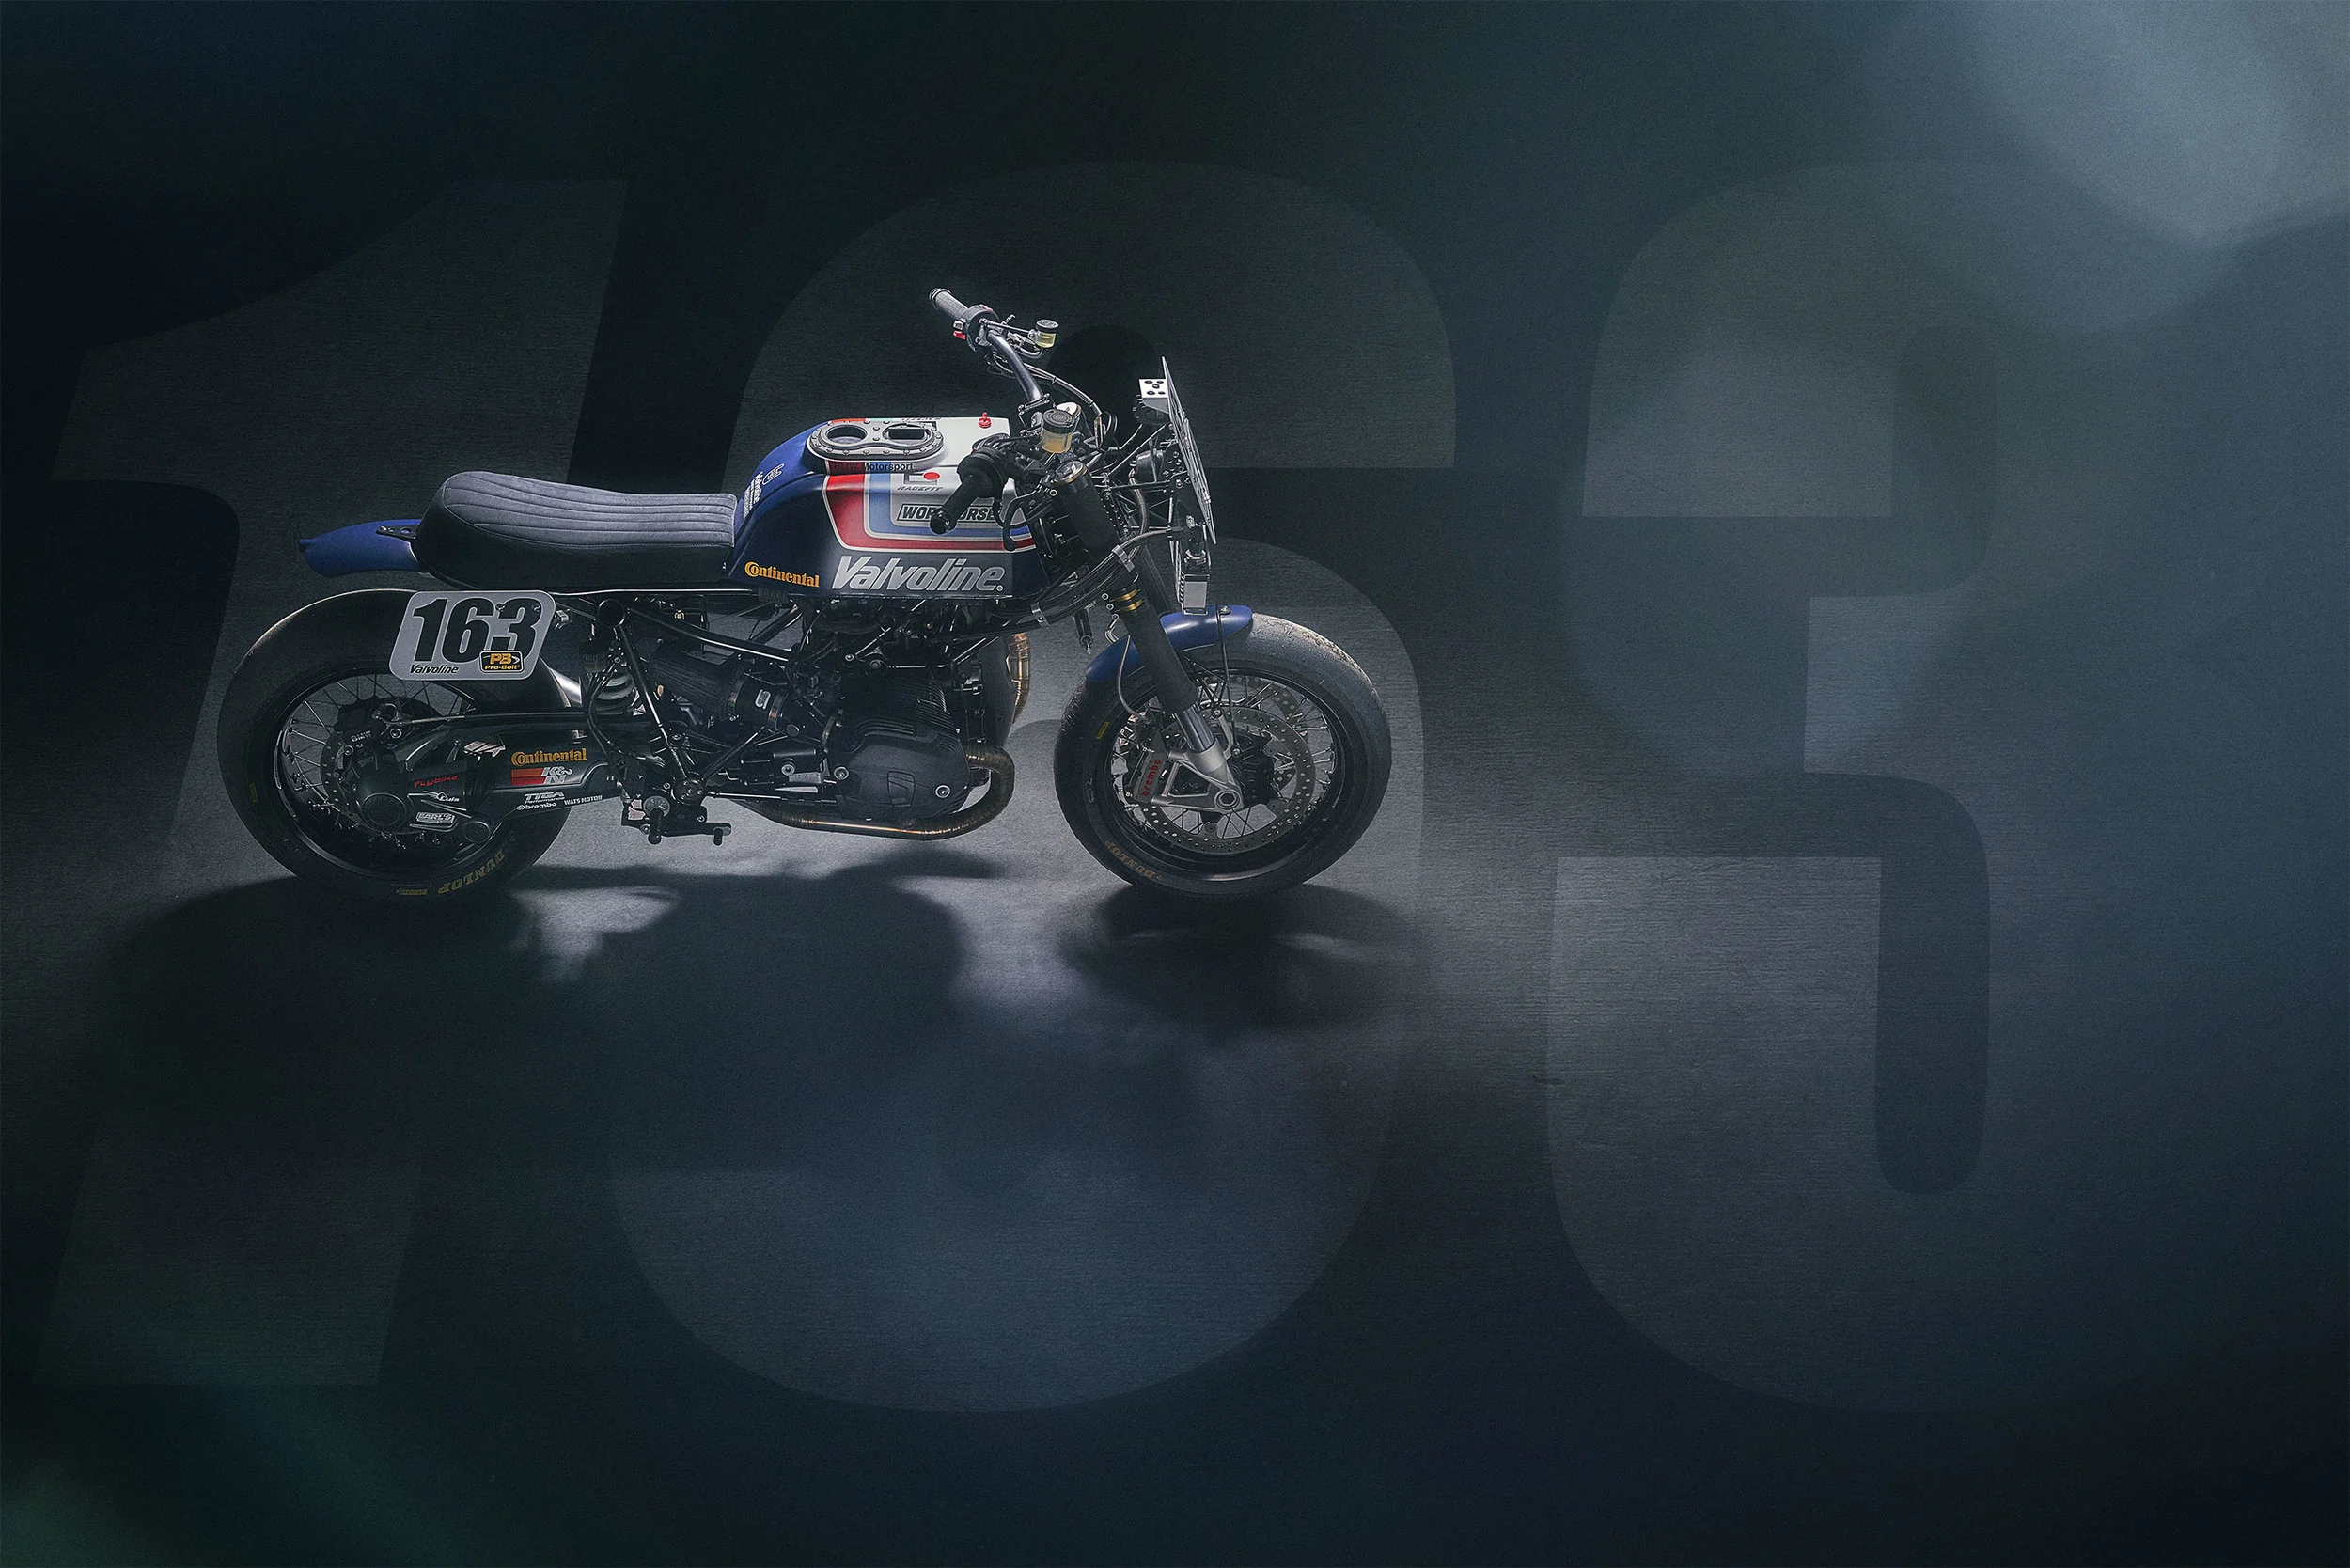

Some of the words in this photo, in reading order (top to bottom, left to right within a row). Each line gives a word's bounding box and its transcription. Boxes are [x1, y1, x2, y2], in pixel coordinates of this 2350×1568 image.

[865, 462, 914, 472] Motorsport
[744, 561, 820, 588] Continental
[832, 555, 1006, 591] Valvoline
[413, 597, 541, 663] 163
[410, 664, 459, 674] Valvoline
[490, 653, 512, 665] PB
[511, 747, 588, 766] Continental
[1139, 759, 1161, 797] brembo
[437, 849, 506, 894] DUNLOP
